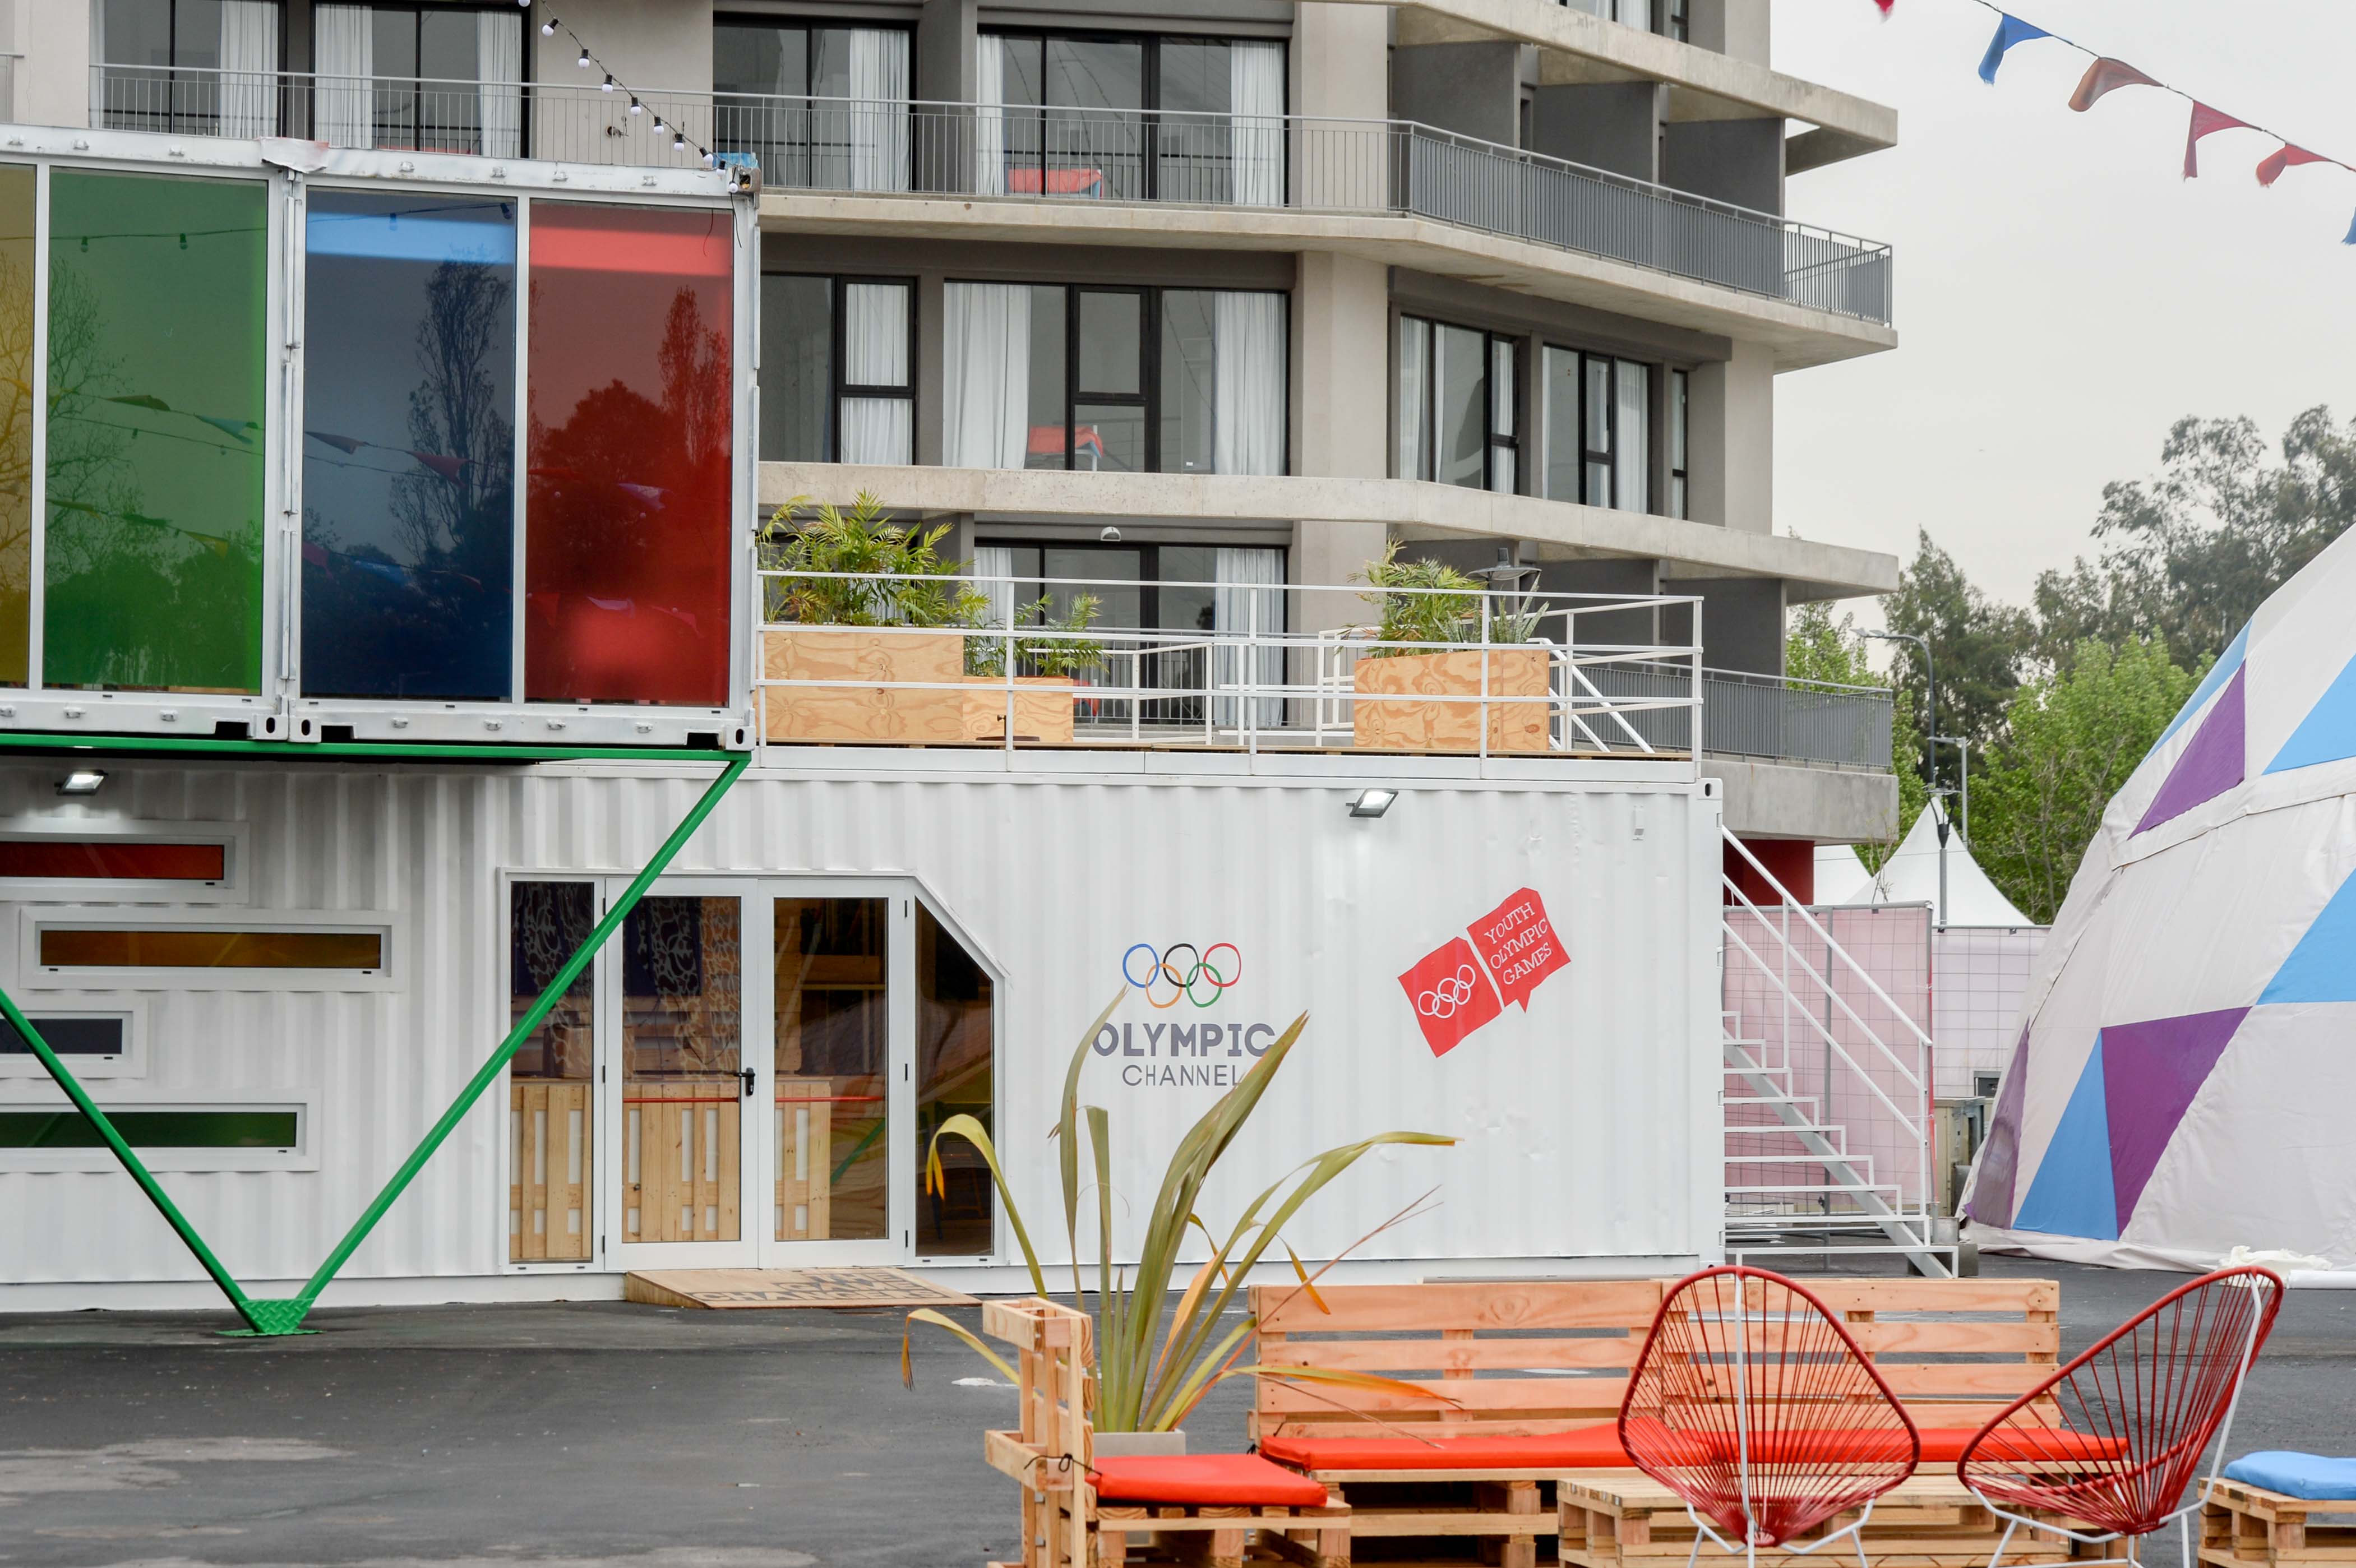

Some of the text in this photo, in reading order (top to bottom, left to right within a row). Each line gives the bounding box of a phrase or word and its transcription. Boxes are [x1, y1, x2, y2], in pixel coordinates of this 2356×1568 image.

[1484, 902, 1535, 944] YOUTH
[1490, 918, 1547, 969] OLYMPIC
[1503, 942, 1552, 984] GAMES
[1092, 1023, 1275, 1056] OLYMPIC
[1122, 1065, 1241, 1085] CHANNEL
[691, 1290, 948, 1301] CHANGERS
[779, 1282, 925, 1290] GAME
